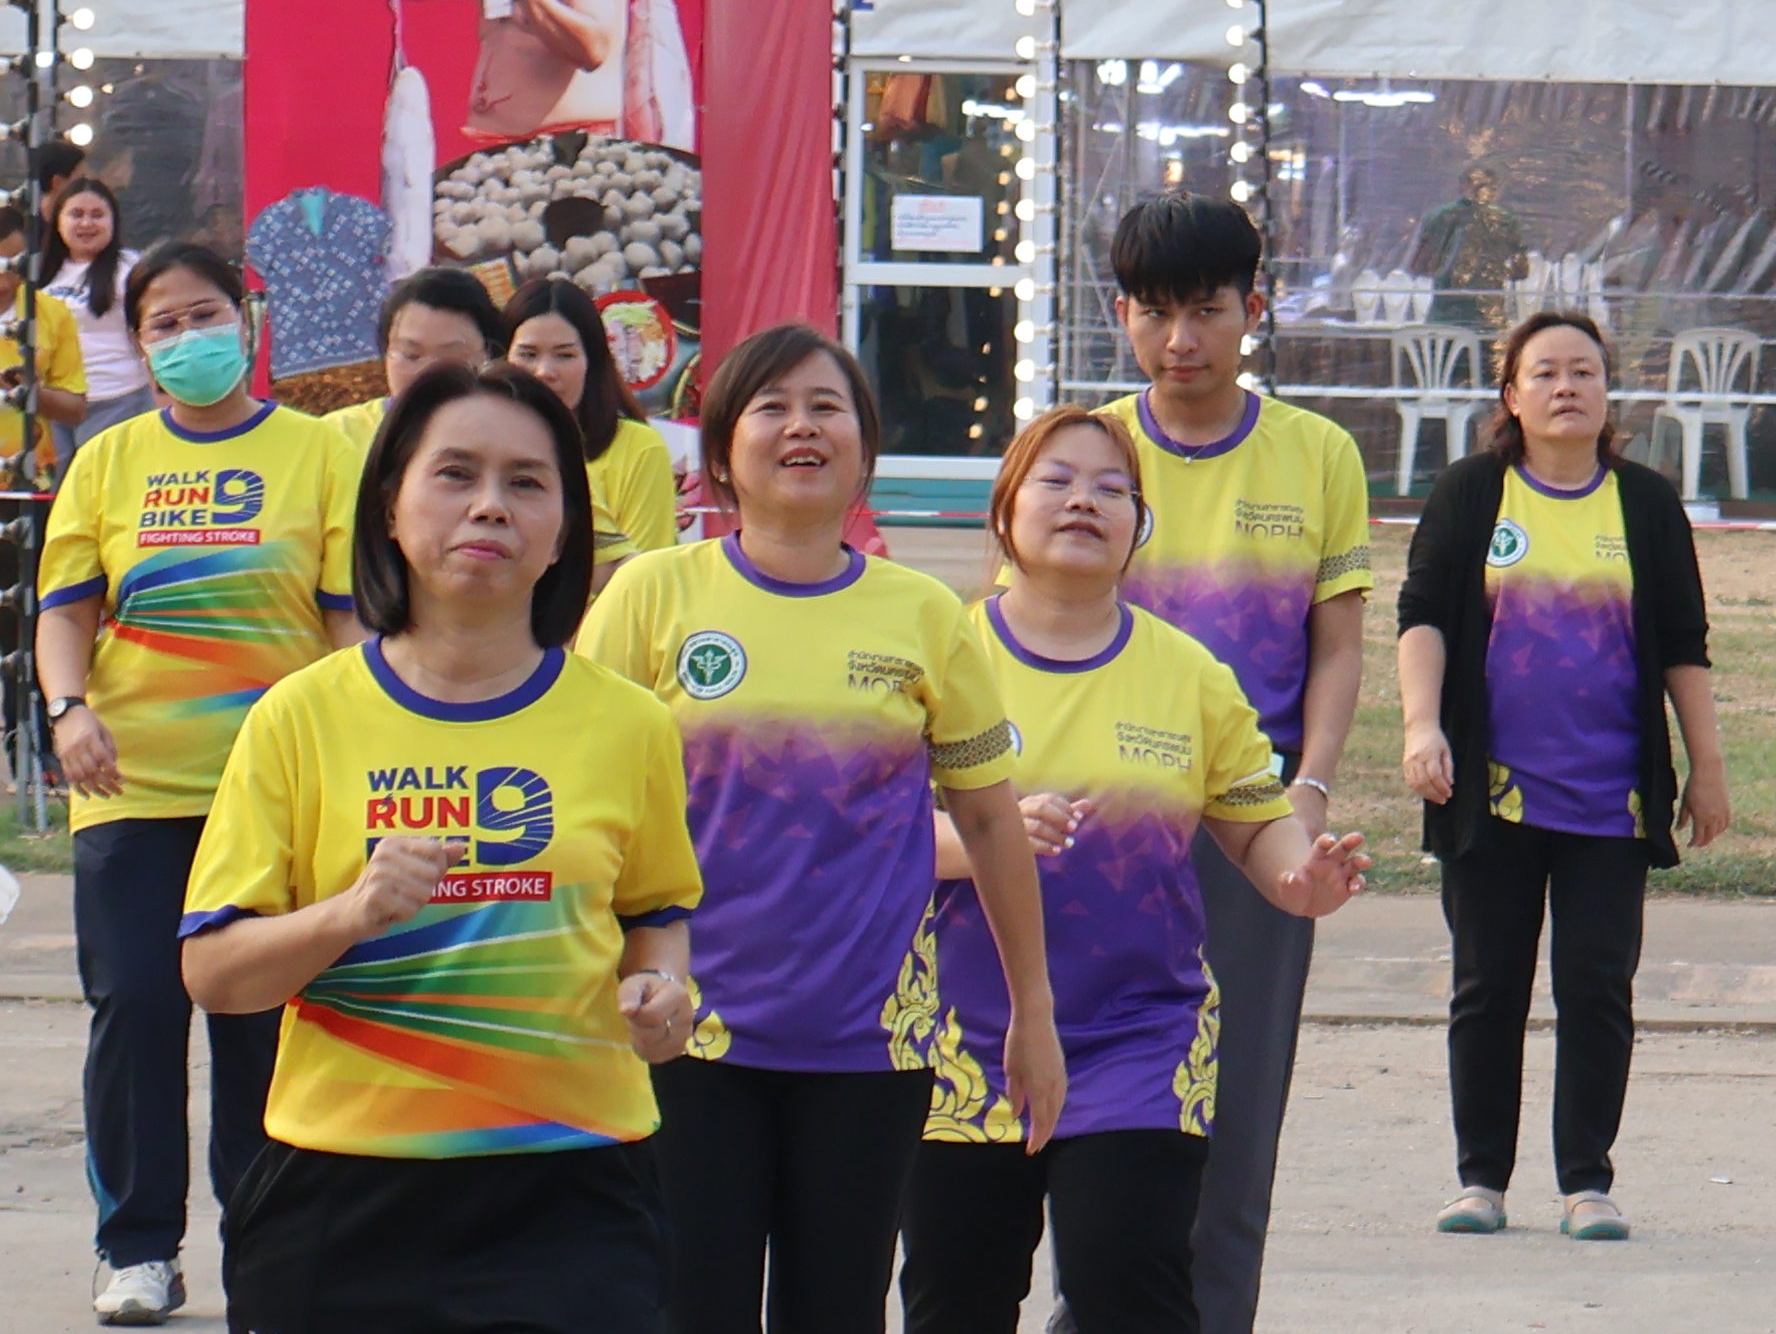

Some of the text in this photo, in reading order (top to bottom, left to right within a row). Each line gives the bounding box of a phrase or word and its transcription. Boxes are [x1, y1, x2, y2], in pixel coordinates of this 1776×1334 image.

[147, 469, 211, 487] WALK
[142, 486, 210, 509] RUN
[211, 469, 265, 525] 9
[138, 509, 208, 529] BIKE
[139, 530, 256, 545] FIGHTING STROKE
[368, 765, 469, 792] WALK
[367, 796, 470, 829] RUN
[476, 766, 554, 866] 9
[471, 877, 546, 897] STROKE
